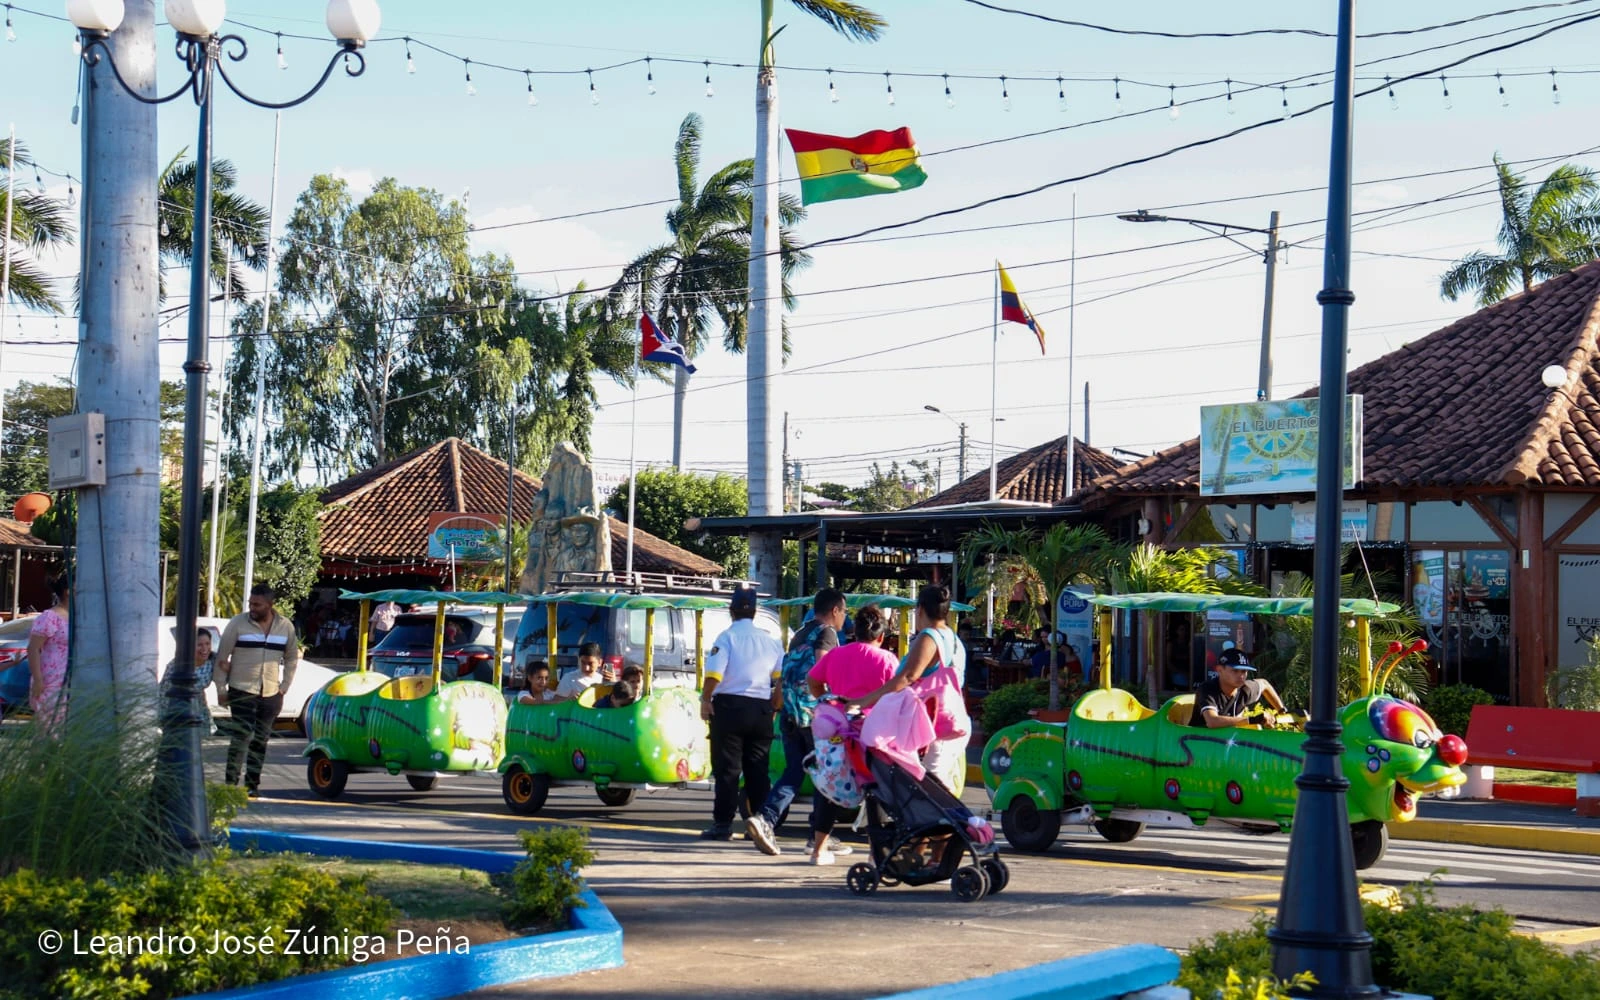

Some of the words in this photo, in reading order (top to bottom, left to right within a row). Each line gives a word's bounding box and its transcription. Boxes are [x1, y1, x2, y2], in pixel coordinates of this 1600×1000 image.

[1232, 421, 1251, 433] EL
[1255, 416, 1319, 431] PUERTO
[445, 538, 462, 546] Las
[1063, 600, 1085, 608] PURA
[1567, 617, 1578, 625] EL
